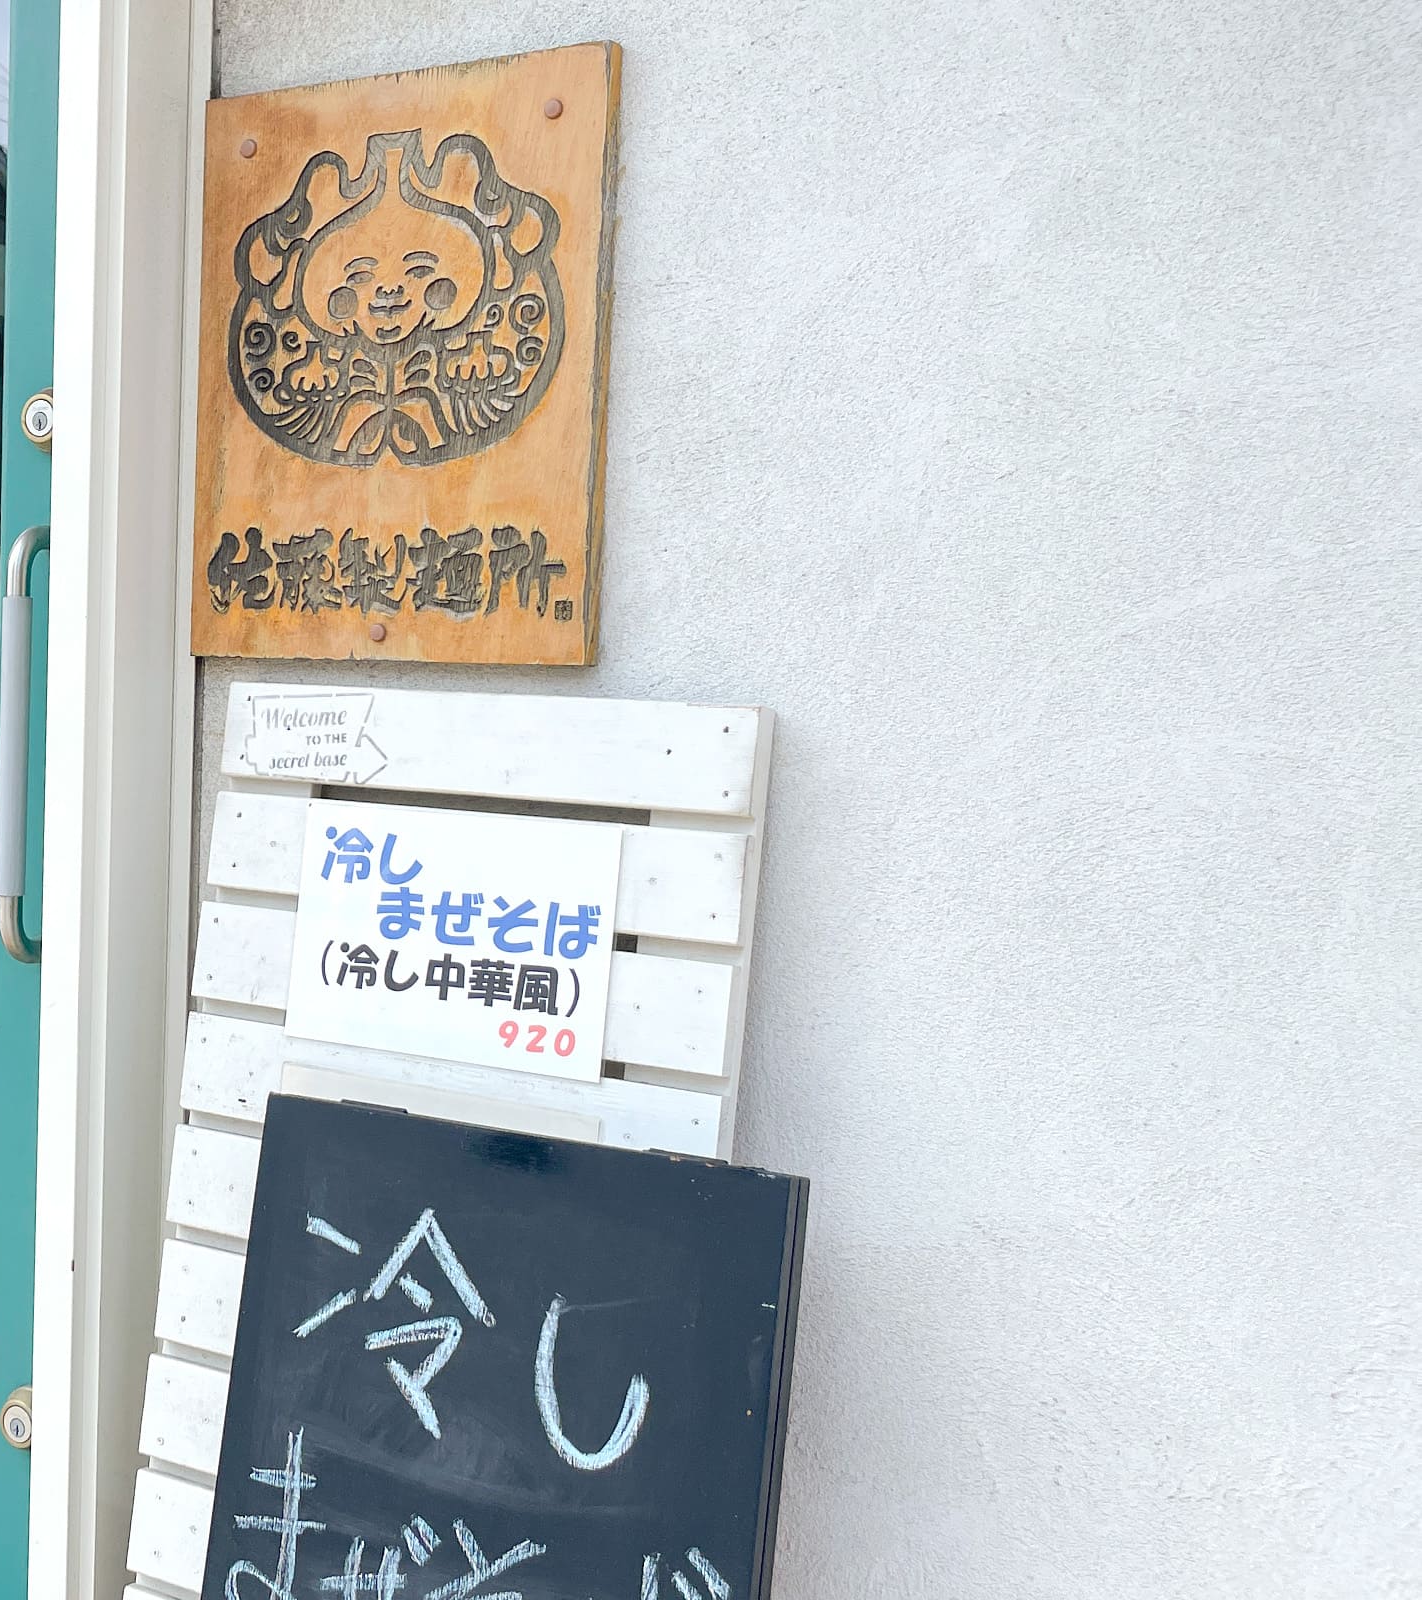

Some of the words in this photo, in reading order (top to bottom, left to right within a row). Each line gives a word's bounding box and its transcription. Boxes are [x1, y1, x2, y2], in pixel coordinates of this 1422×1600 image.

[207, 526, 568, 618] 佐藤製麺所
[261, 708, 348, 730] Welcome
[305, 734, 322, 746] TO
[324, 732, 347, 745] THE
[313, 751, 348, 767] base
[320, 825, 424, 886] 冷し
[376, 886, 602, 959] まぜそば
[320, 938, 581, 1019] (冷し中華風)
[497, 1019, 577, 1058] 920
[292, 1207, 650, 1471] 冷し
